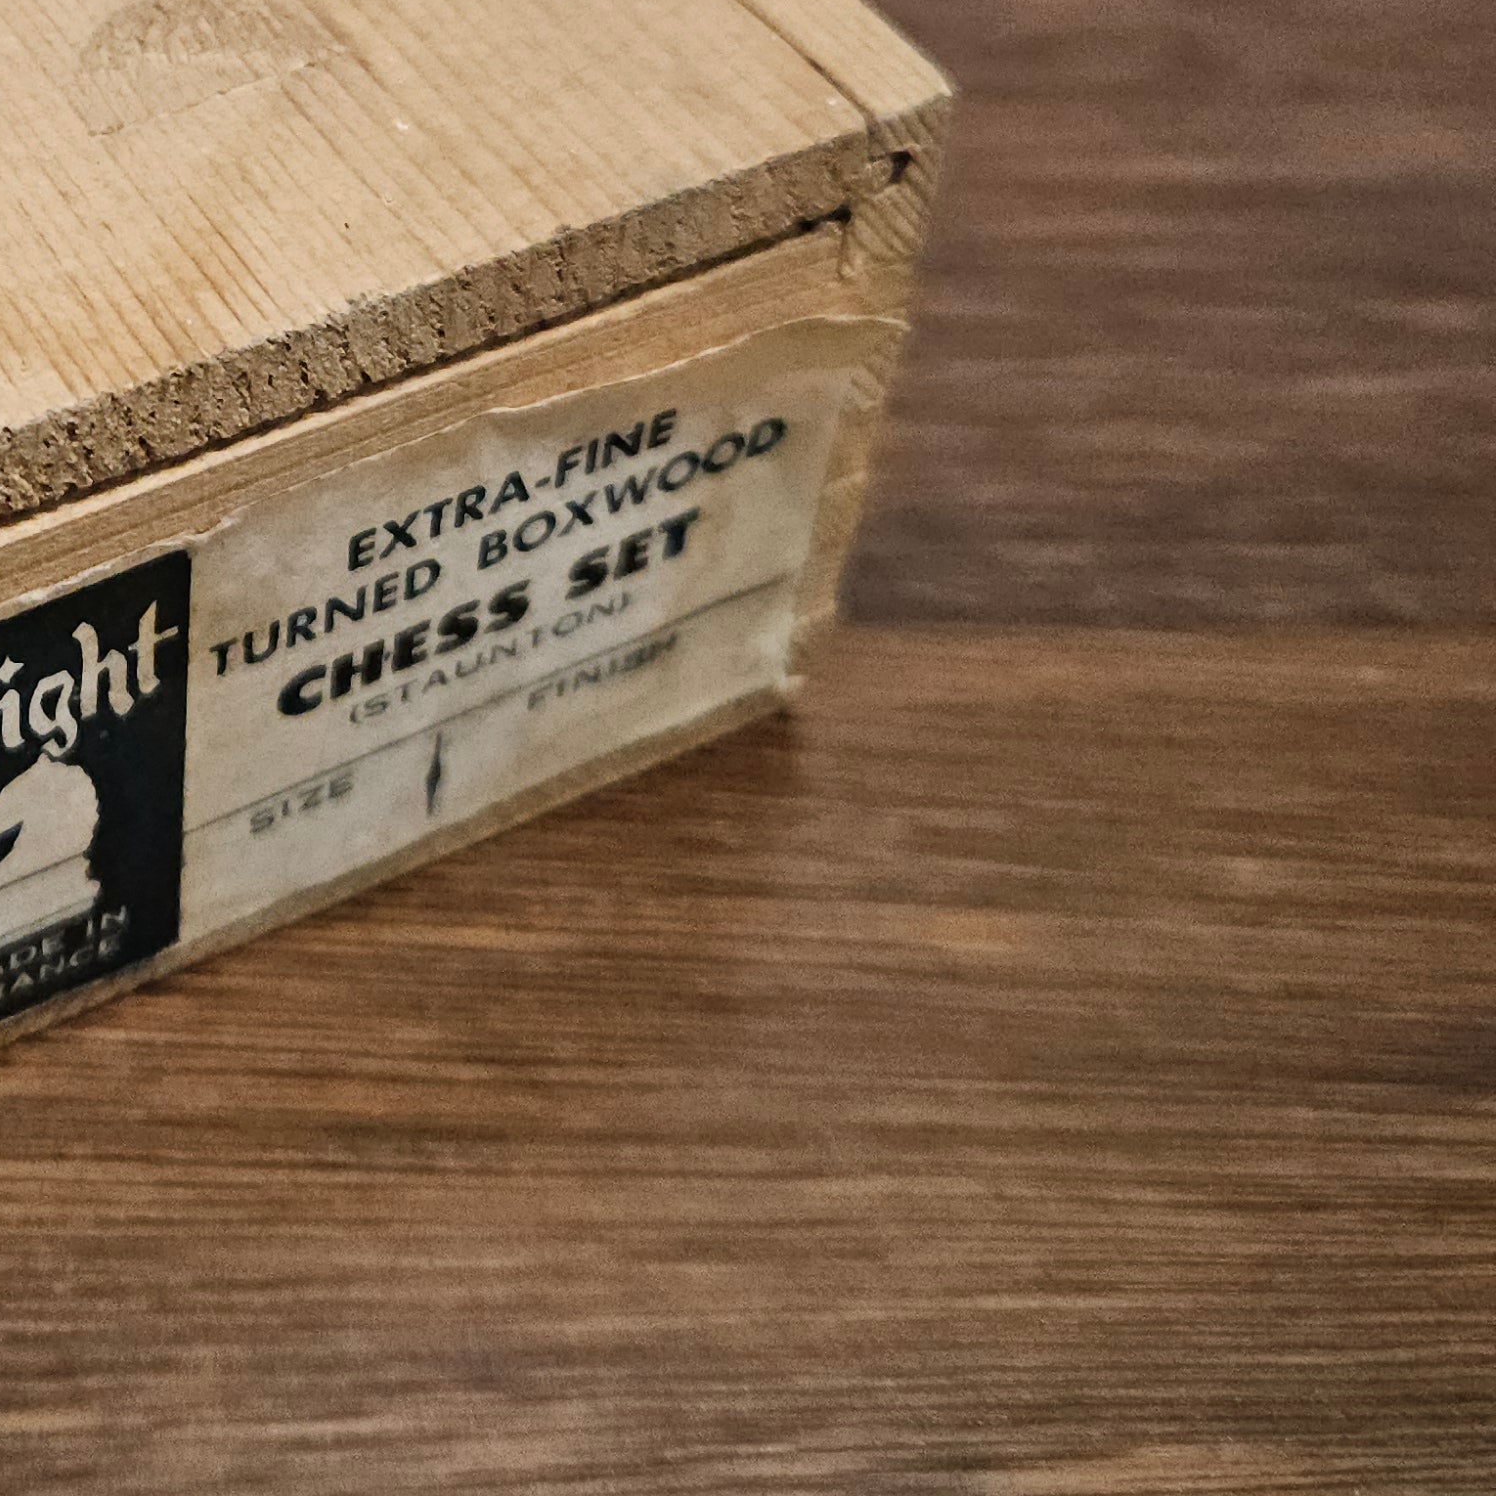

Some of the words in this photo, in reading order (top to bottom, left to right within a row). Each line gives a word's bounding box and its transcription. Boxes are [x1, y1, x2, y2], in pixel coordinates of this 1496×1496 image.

[209, 557, 442, 677] TURNED
[476, 416, 788, 571] BOXWOOD
[346, 408, 679, 572] EXTRA-FINE
[276, 579, 533, 717] CHESS
[565, 505, 702, 600] SET
[349, 591, 630, 725] (STAUNTON)
[526, 631, 679, 712] FINISH
[249, 771, 355, 835] SIZE
[84, 903, 131, 942] IN
